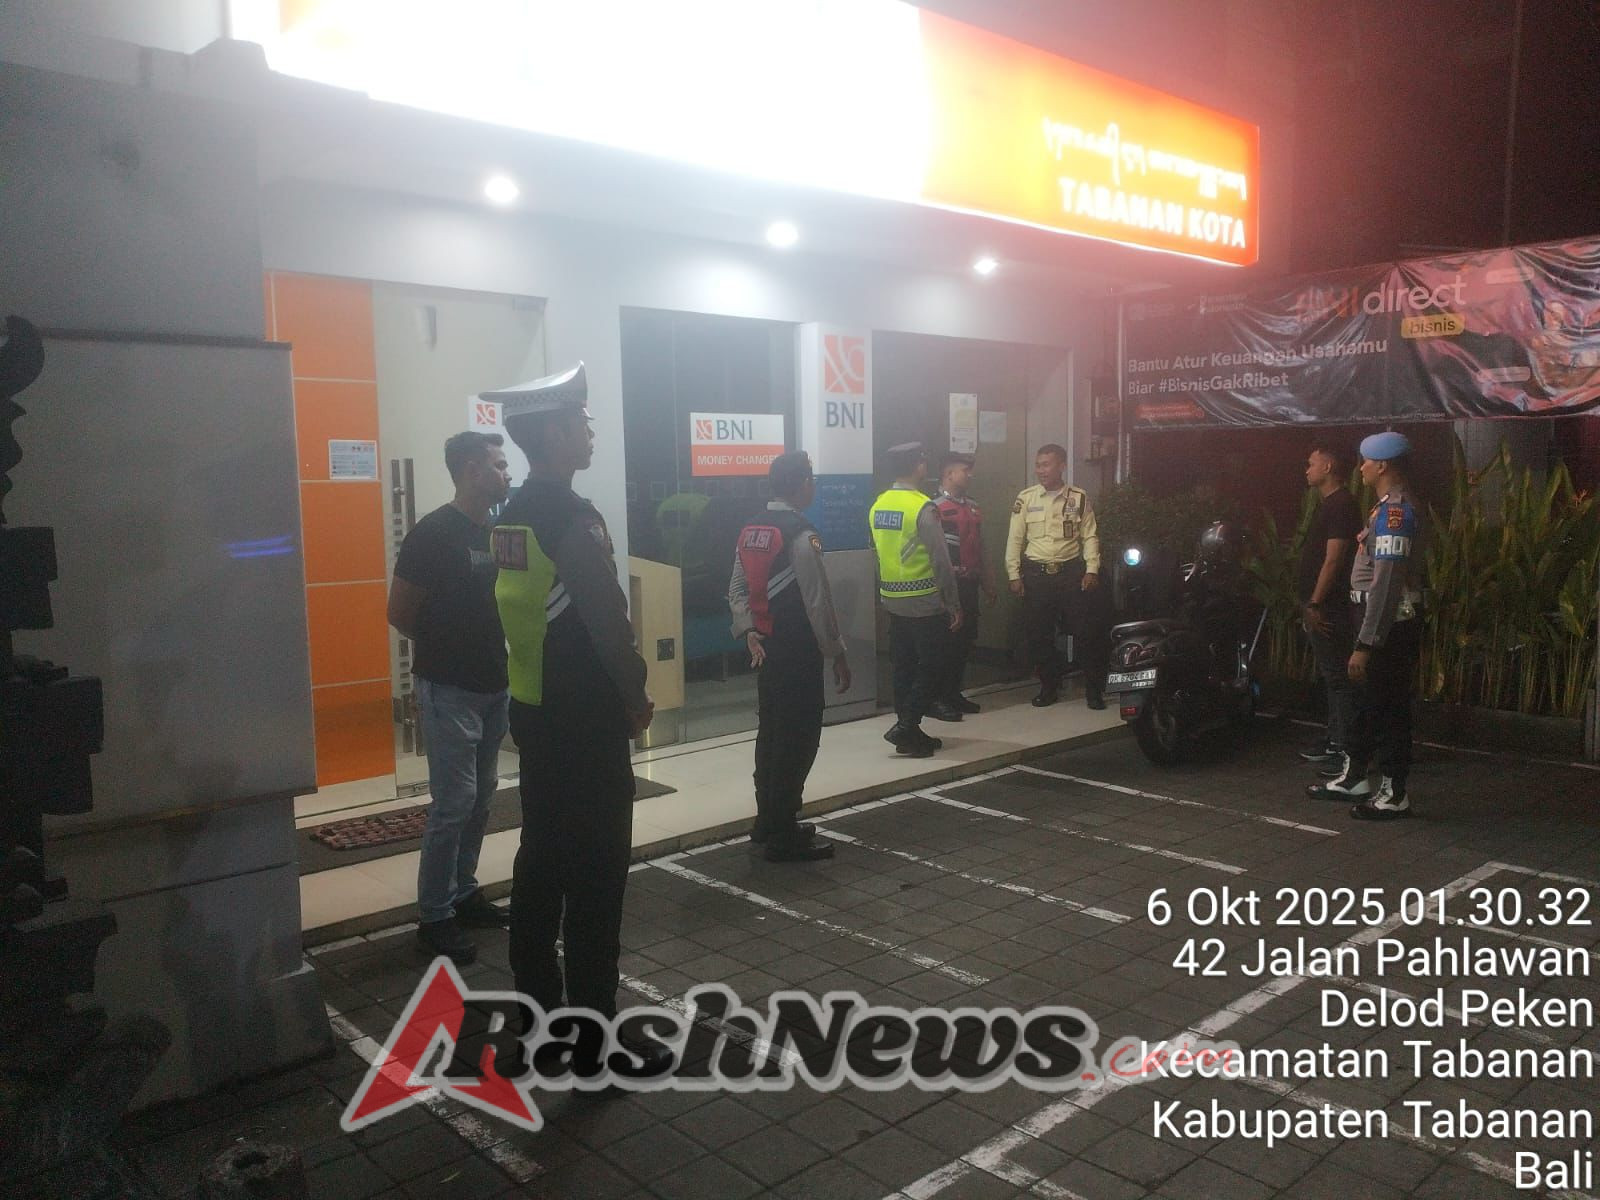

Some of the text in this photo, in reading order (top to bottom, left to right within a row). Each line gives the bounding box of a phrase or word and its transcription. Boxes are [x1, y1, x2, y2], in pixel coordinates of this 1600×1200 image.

[1058, 176, 1246, 249] TABANAN KOTA
[1363, 274, 1468, 316] direct
[1409, 317, 1456, 335] bisnis
[1128, 359, 1169, 373] Bantu
[1173, 355, 1206, 371] Atur
[1128, 371, 1289, 396] Biar #BisnisGakRibet
[825, 401, 865, 429] BNI
[716, 419, 752, 440] BNI
[697, 455, 733, 465] MONEY
[876, 513, 902, 527] POLISI
